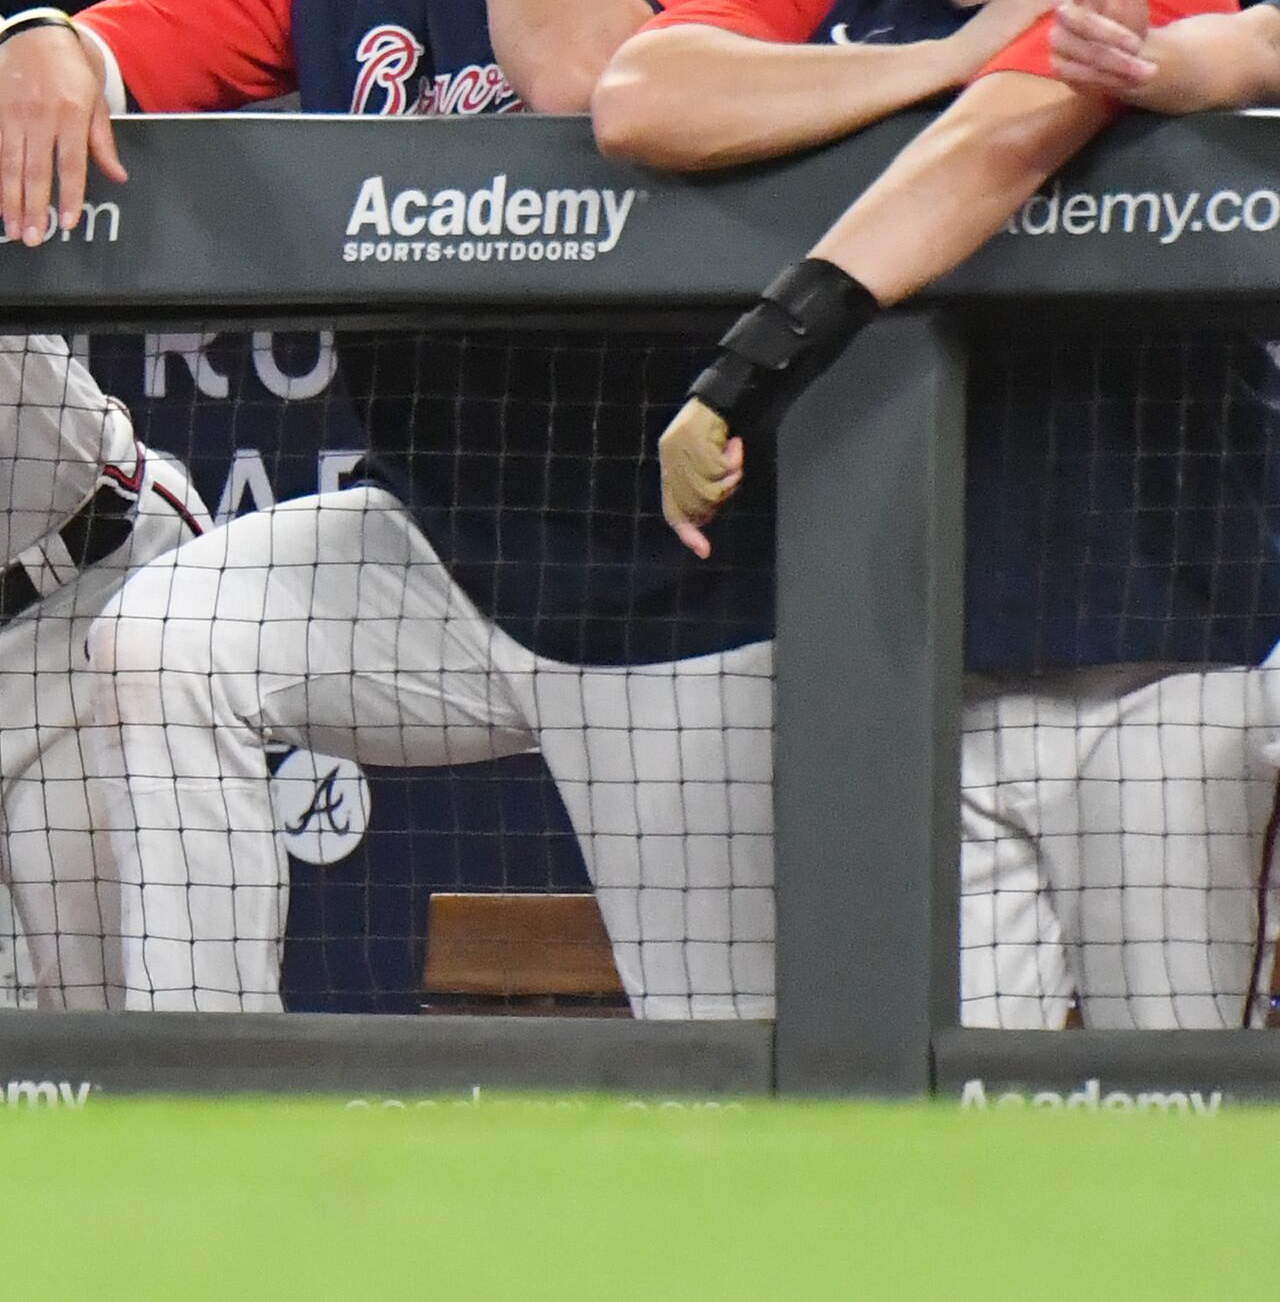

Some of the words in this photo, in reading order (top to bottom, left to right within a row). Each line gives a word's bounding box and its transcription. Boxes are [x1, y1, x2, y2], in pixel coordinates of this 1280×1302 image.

[346, 173, 637, 253] Academy
[1002, 180, 1280, 244] demy.co
[343, 241, 596, 262] SPORTS+OUTDOORS
[284, 766, 351, 839] A
